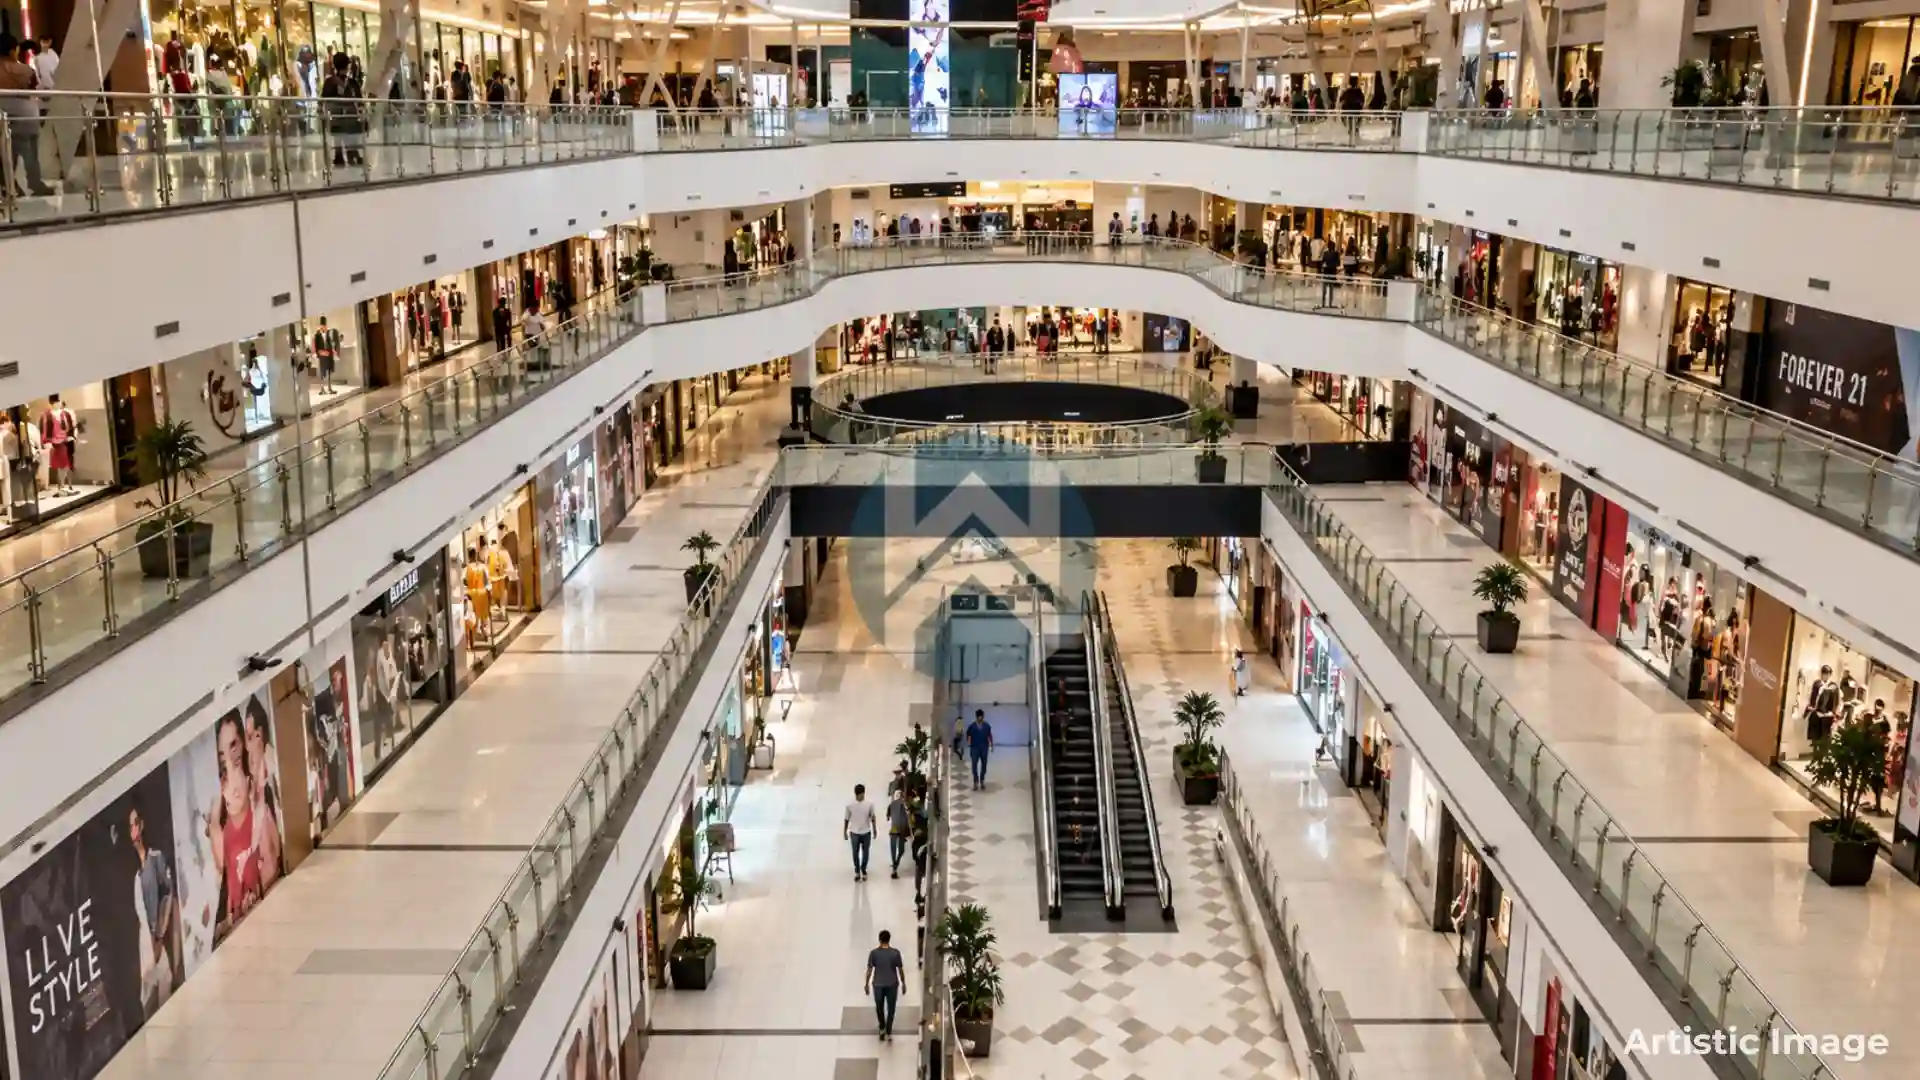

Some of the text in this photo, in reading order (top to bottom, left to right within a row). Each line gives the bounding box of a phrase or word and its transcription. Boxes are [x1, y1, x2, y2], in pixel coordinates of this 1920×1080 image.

[1778, 351, 1868, 407] FOREVER 21
[29, 941, 102, 1034] STYLE
